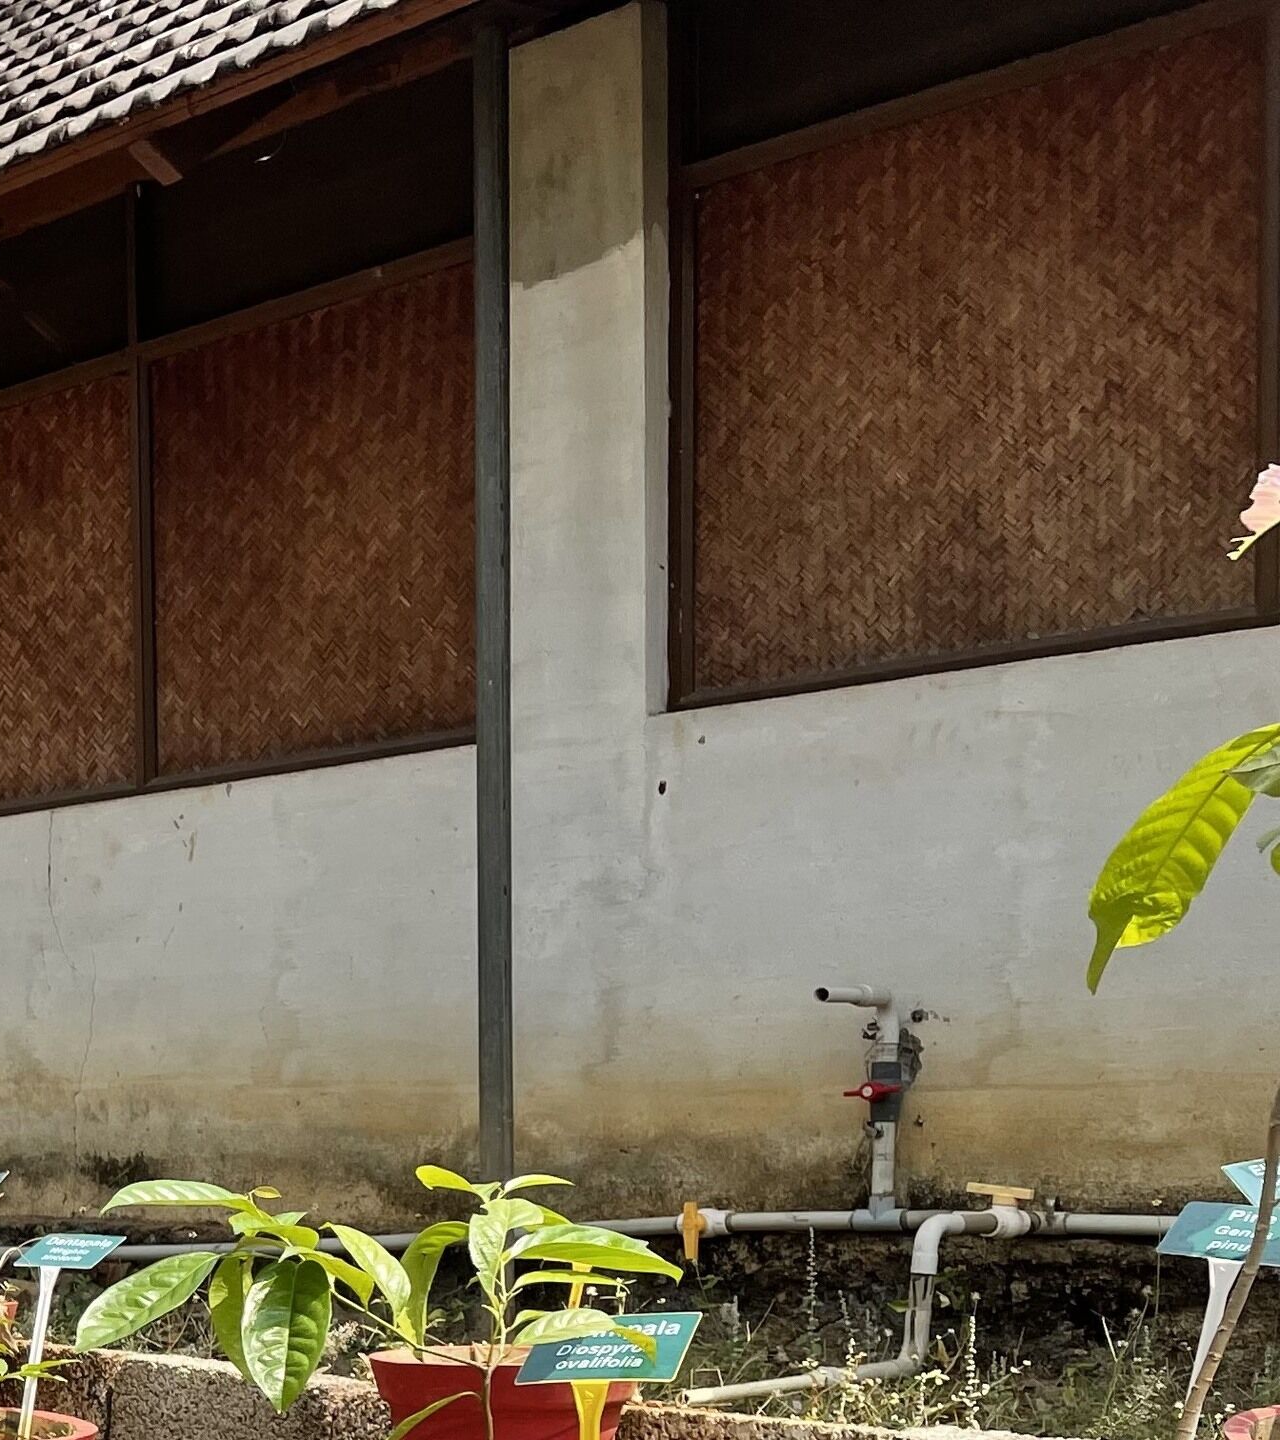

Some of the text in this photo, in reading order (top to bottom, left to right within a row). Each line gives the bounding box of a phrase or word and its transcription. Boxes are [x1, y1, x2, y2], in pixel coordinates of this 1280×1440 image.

[1206, 1240, 1255, 1252] pinu
[556, 1343, 646, 1357] Diospyro
[555, 1356, 644, 1371] ovalifolia
